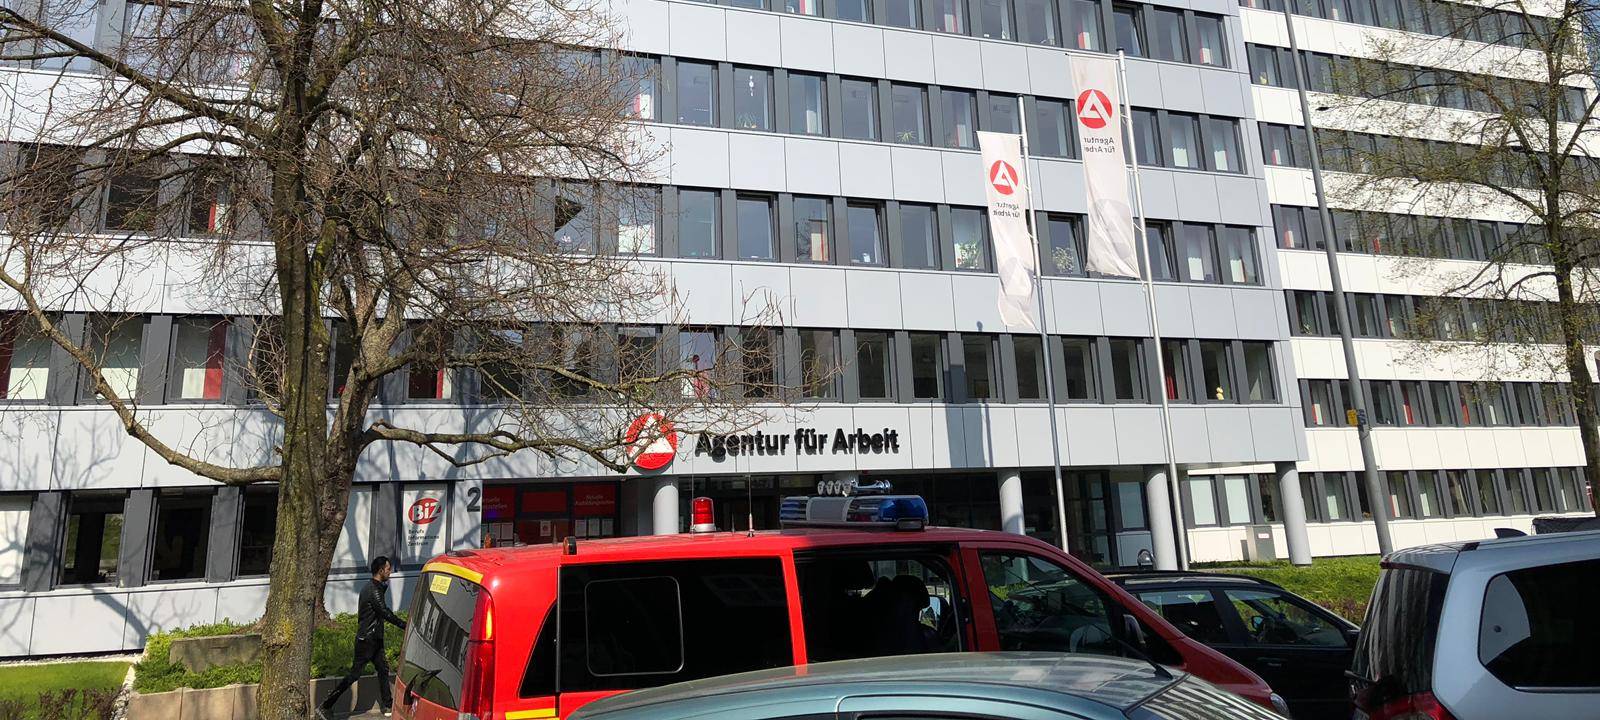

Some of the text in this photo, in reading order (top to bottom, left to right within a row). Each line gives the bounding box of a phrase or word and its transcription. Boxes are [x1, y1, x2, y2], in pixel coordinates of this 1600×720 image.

[695, 427, 900, 462] Agentur für Arbeit
[466, 486, 481, 512] 2
